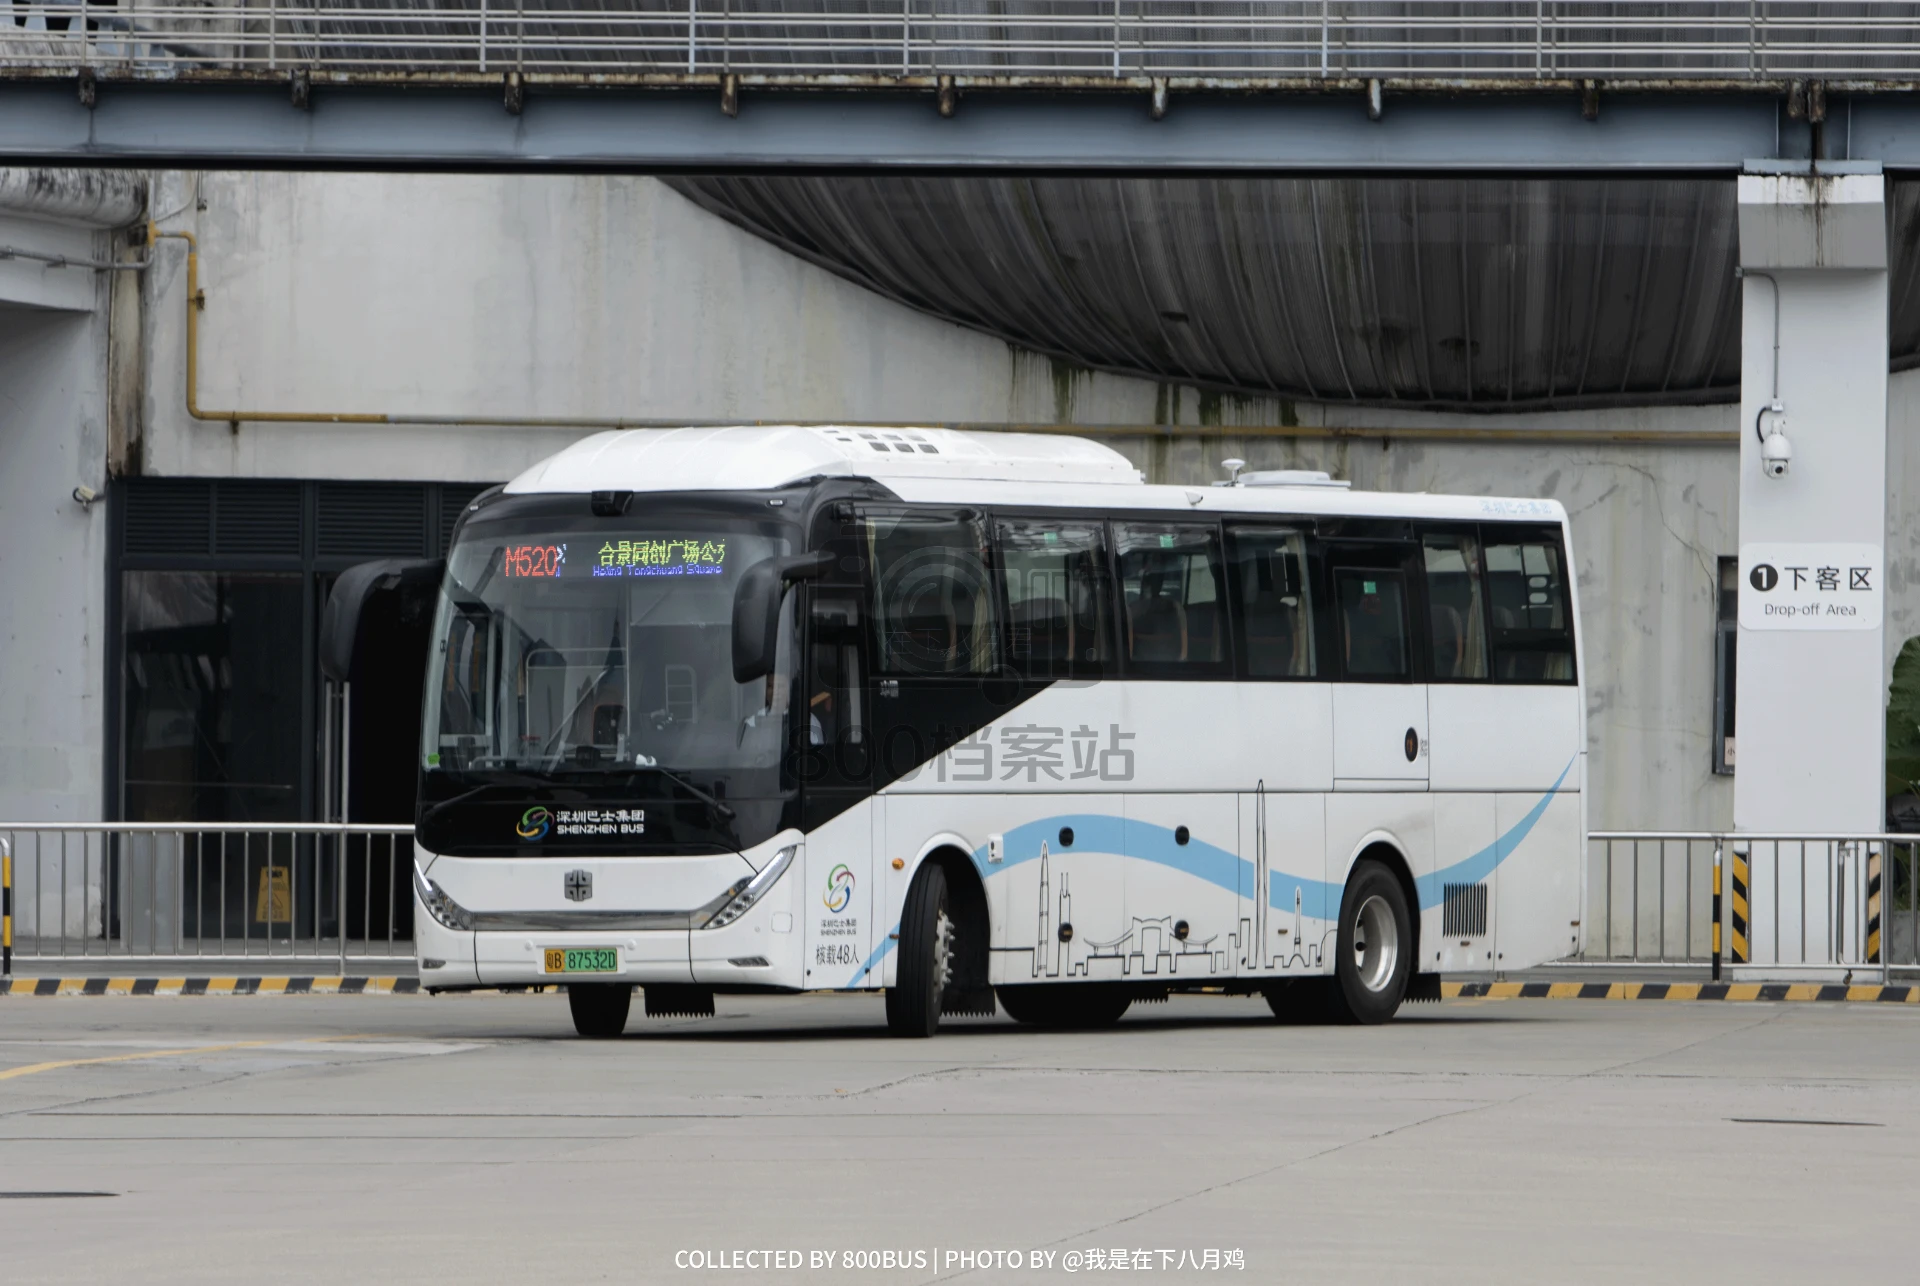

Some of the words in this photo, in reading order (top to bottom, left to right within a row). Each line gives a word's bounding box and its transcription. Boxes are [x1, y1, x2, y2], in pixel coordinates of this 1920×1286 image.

[505, 545, 558, 577] M520
[1784, 565, 1873, 592] 下客区
[1764, 603, 1821, 618] Drop-off
[1826, 603, 1857, 616] Area
[556, 809, 645, 824] 深圳巴士集团
[556, 824, 617, 835] SHENZHEN
[620, 823, 645, 834] BUS
[820, 928, 846, 936] SHENZHEN
[846, 927, 857, 936] BUS
[815, 943, 860, 966] 核载48人
